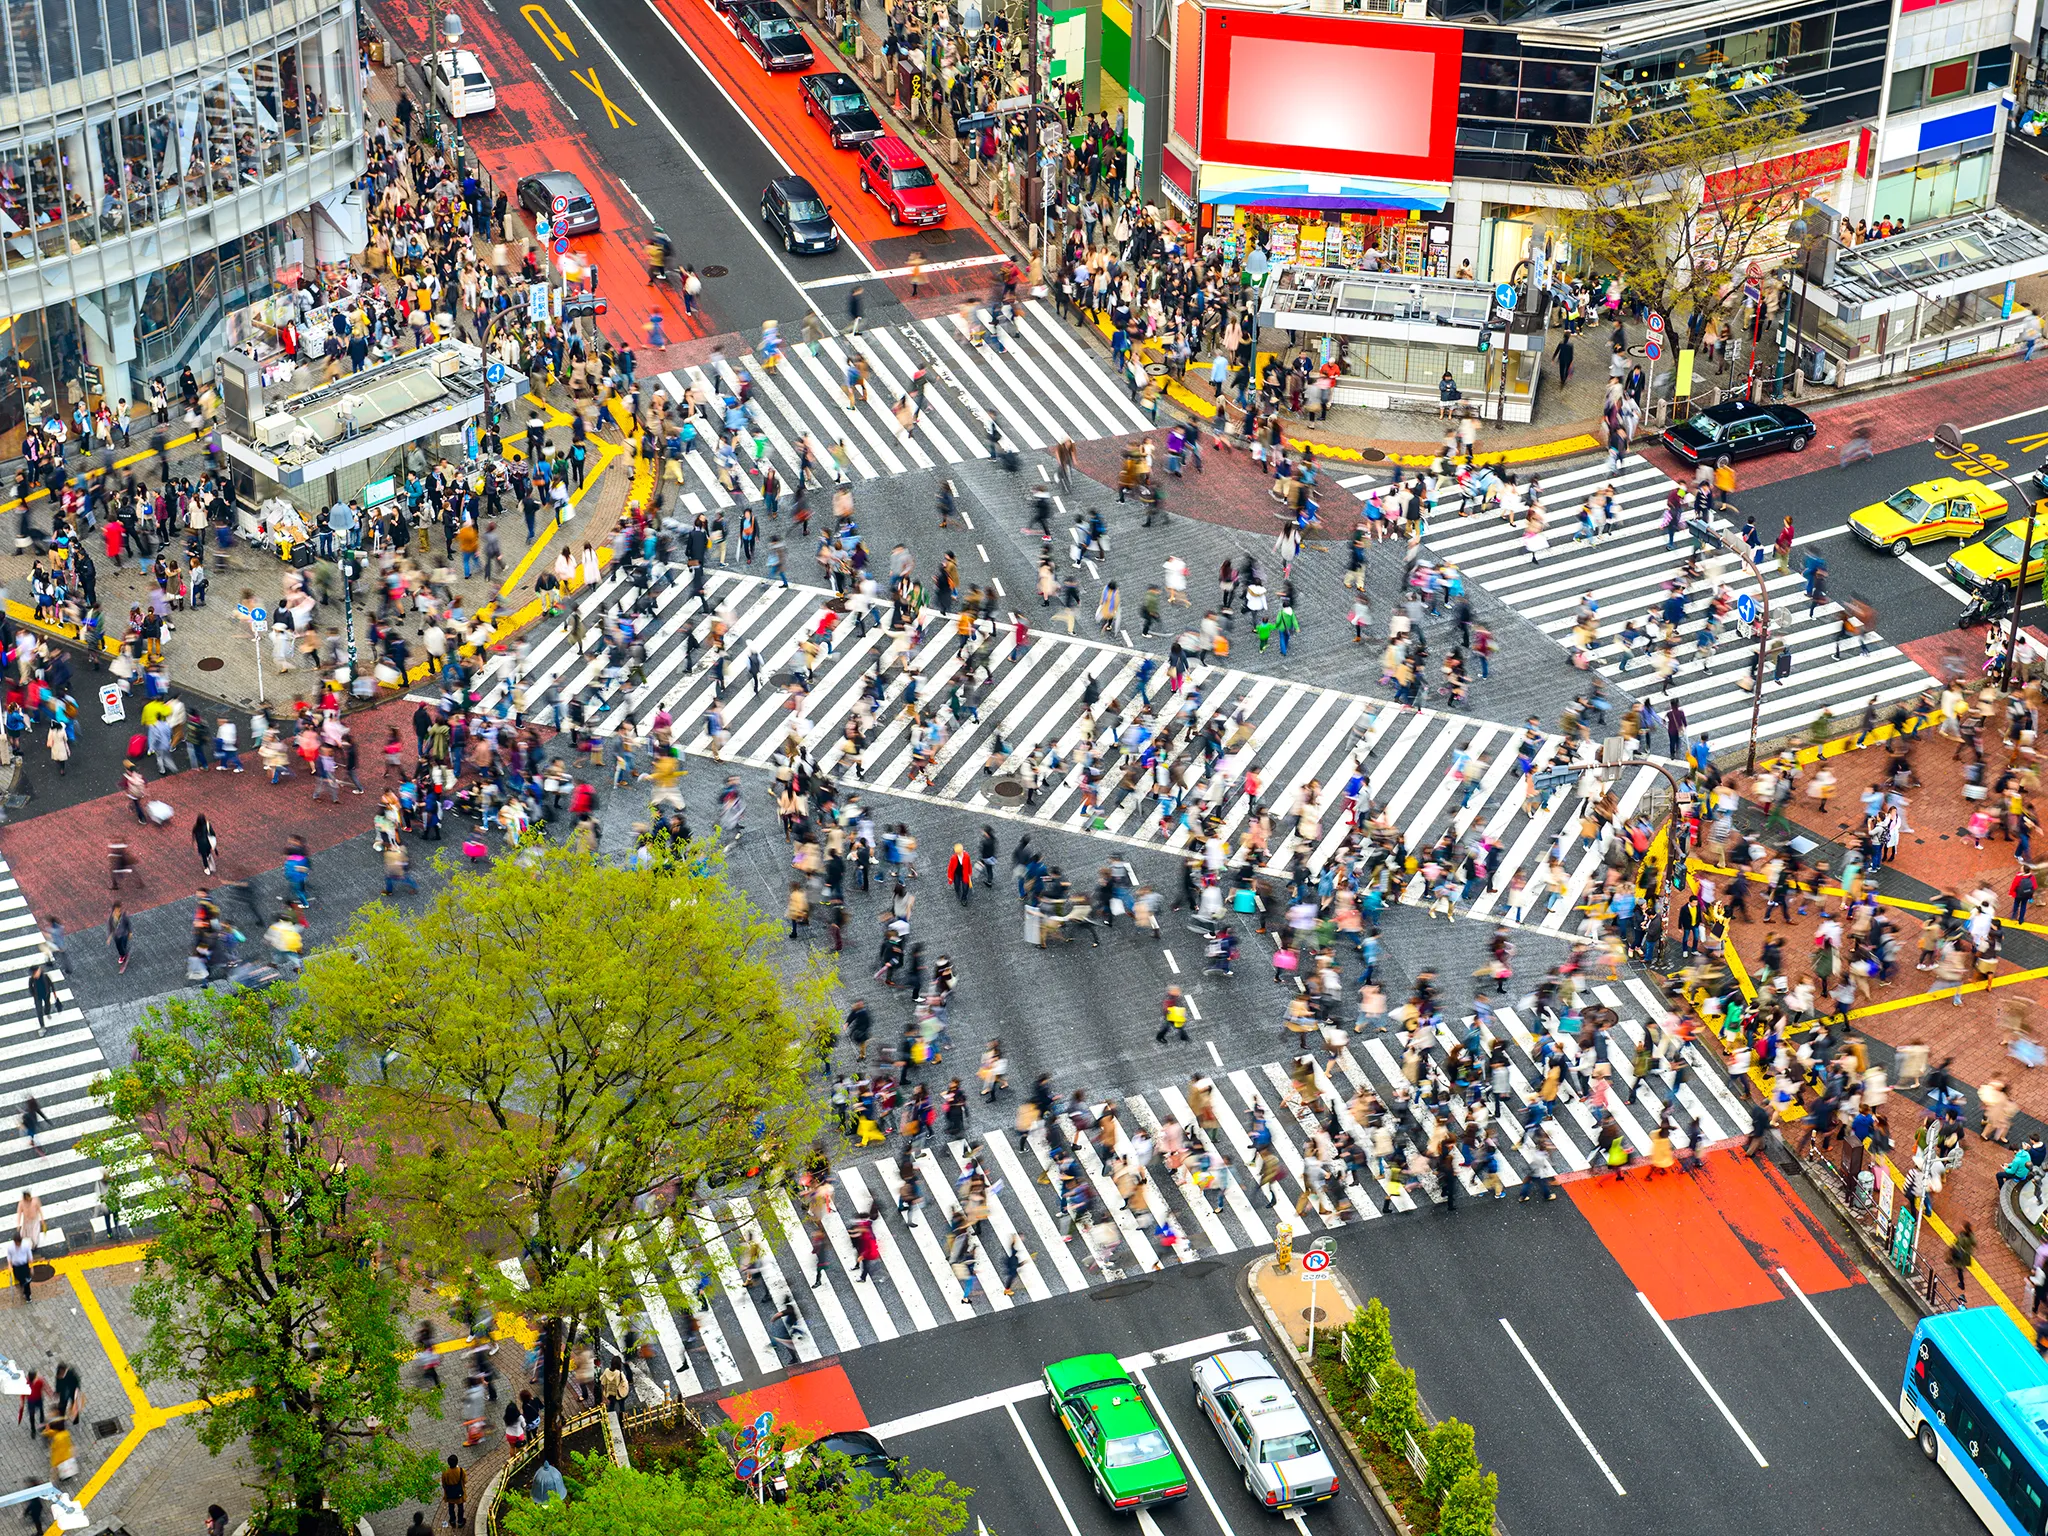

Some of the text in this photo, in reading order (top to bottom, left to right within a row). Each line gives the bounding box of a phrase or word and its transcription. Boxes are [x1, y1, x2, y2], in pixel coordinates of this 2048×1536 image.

[537, 287, 547, 318] 渋谷駅前
[1302, 1273, 1328, 1281] ここから
